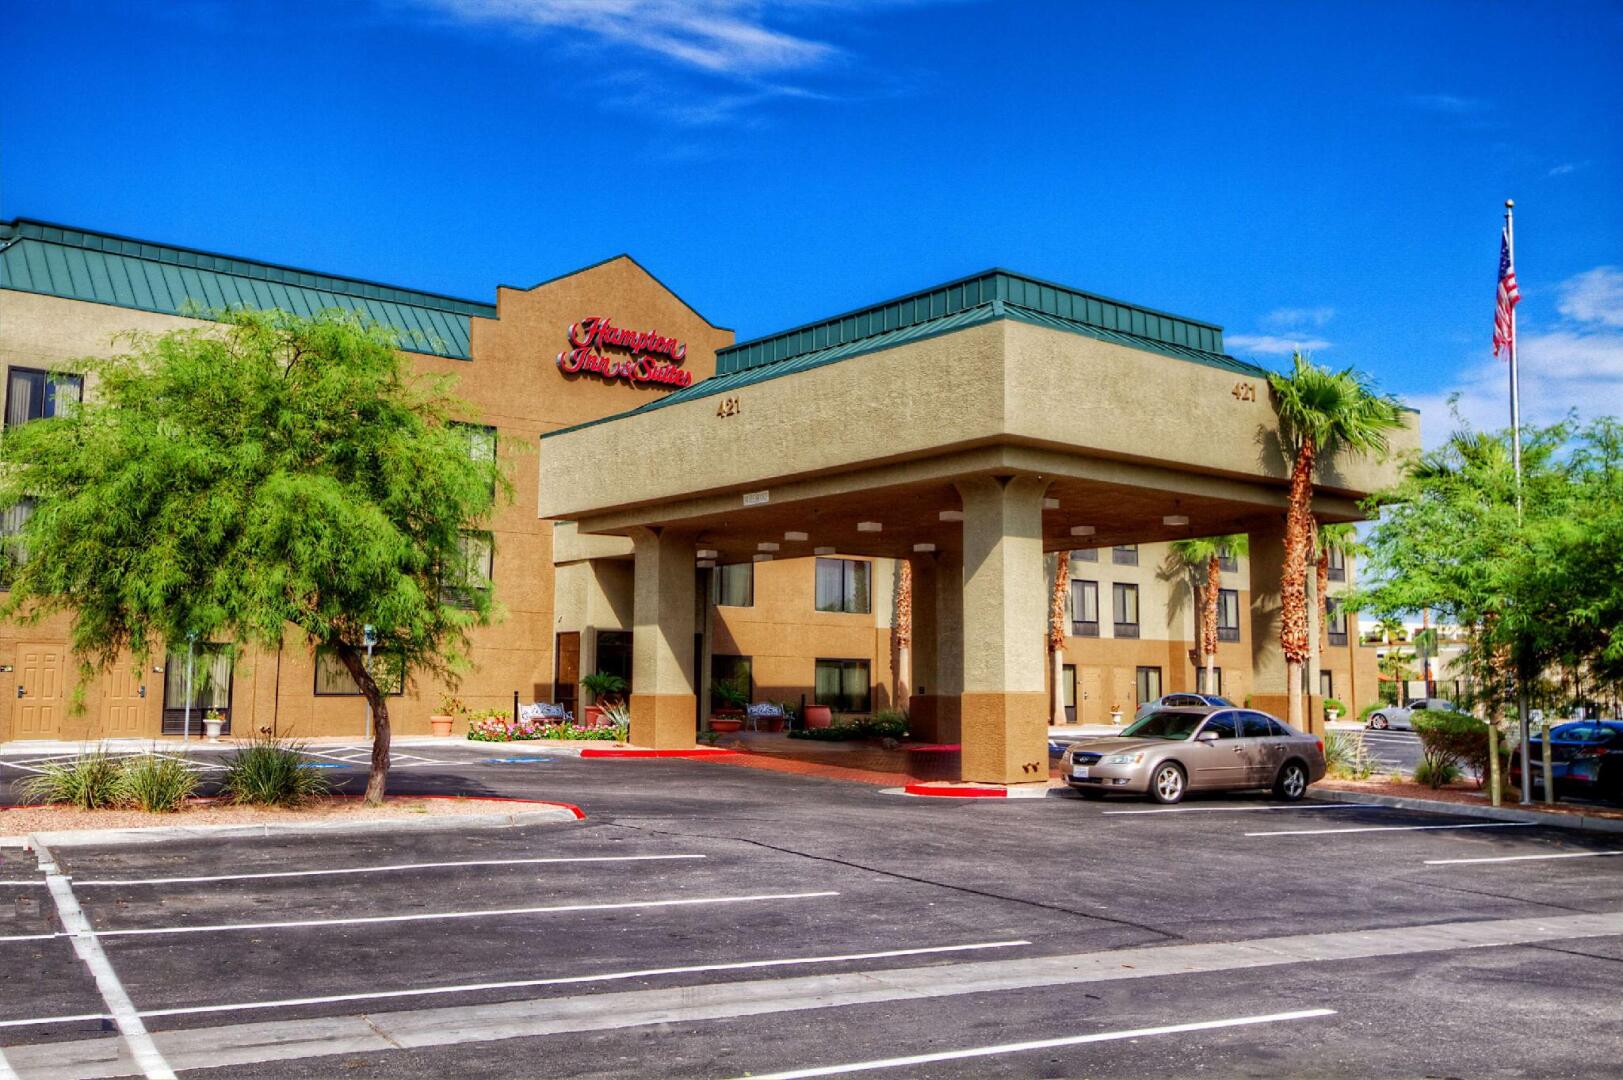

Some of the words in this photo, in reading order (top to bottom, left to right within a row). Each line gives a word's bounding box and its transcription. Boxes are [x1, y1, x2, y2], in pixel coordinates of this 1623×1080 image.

[568, 317, 687, 360] Hampton
[556, 347, 620, 378] Inn
[632, 355, 693, 388] Suites
[716, 396, 740, 419] 421
[1231, 382, 1256, 402] 421
